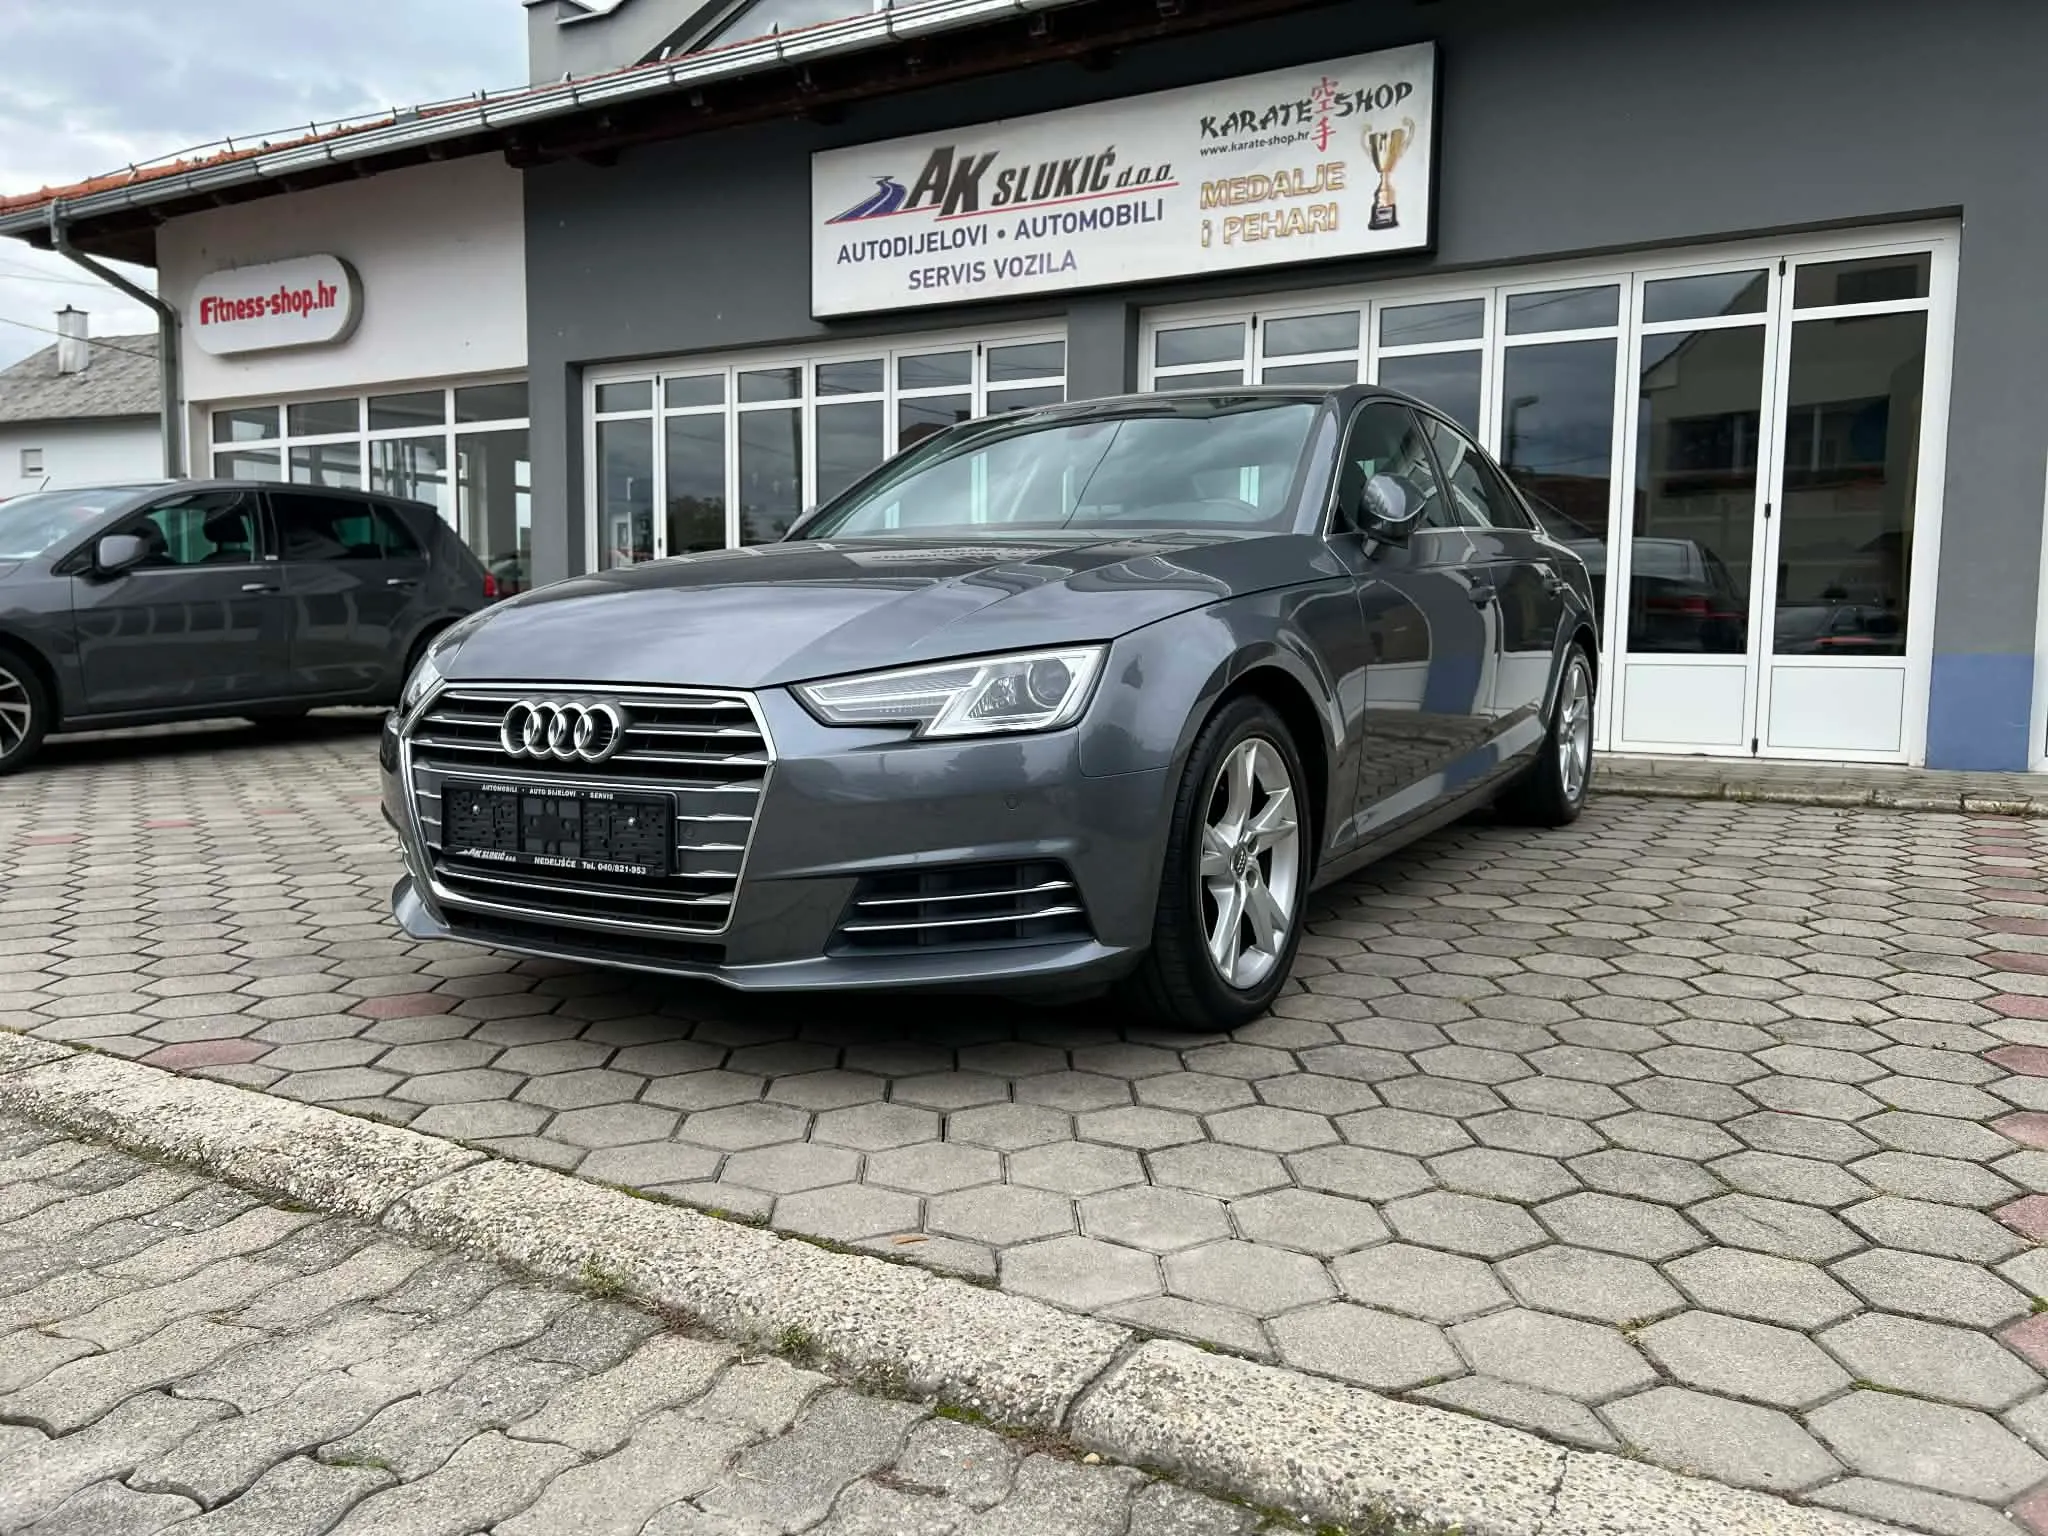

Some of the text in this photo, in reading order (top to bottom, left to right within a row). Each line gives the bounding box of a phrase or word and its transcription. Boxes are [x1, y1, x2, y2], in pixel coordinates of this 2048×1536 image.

[1200, 81, 1413, 139] KARATE SHOP
[1200, 130, 1310, 157] www.karate-shop.hr
[901, 145, 1000, 217] AK
[990, 145, 1118, 207] SLUKIĆ
[1200, 161, 1346, 210] MEDALJE
[837, 199, 1165, 265] AUTODIJELOVI AUTOMOBILI
[1201, 202, 1339, 248] i PEHARI
[908, 249, 1077, 290] SERVIS VOZILA
[200, 280, 338, 326] Fitness-shop.hr
[481, 784, 518, 793] AUTOMOBILI
[529, 787, 546, 796] AUTO
[589, 792, 614, 800] SERVIS
